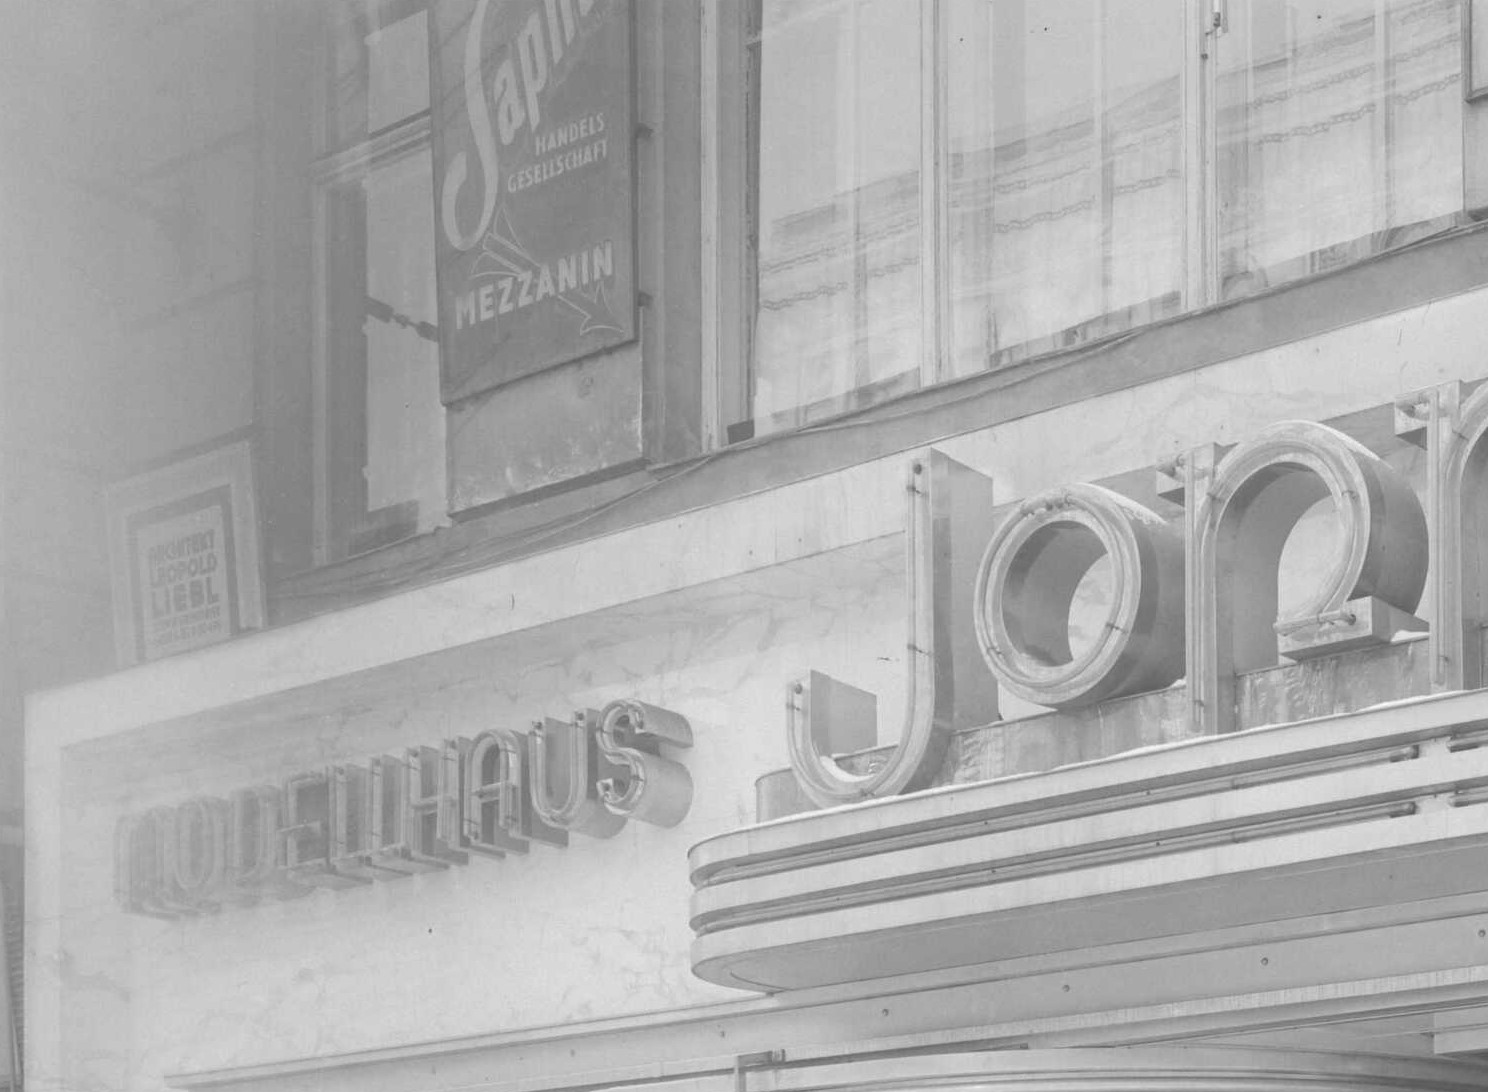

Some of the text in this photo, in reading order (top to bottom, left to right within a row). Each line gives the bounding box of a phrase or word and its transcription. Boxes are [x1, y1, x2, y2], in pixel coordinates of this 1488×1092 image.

[507, 139, 608, 194] GESELLSCHAFT
[535, 113, 605, 156] HANDELS
[455, 240, 614, 330] MEZZANIN
[112, 698, 693, 920] MODELLHAUS
